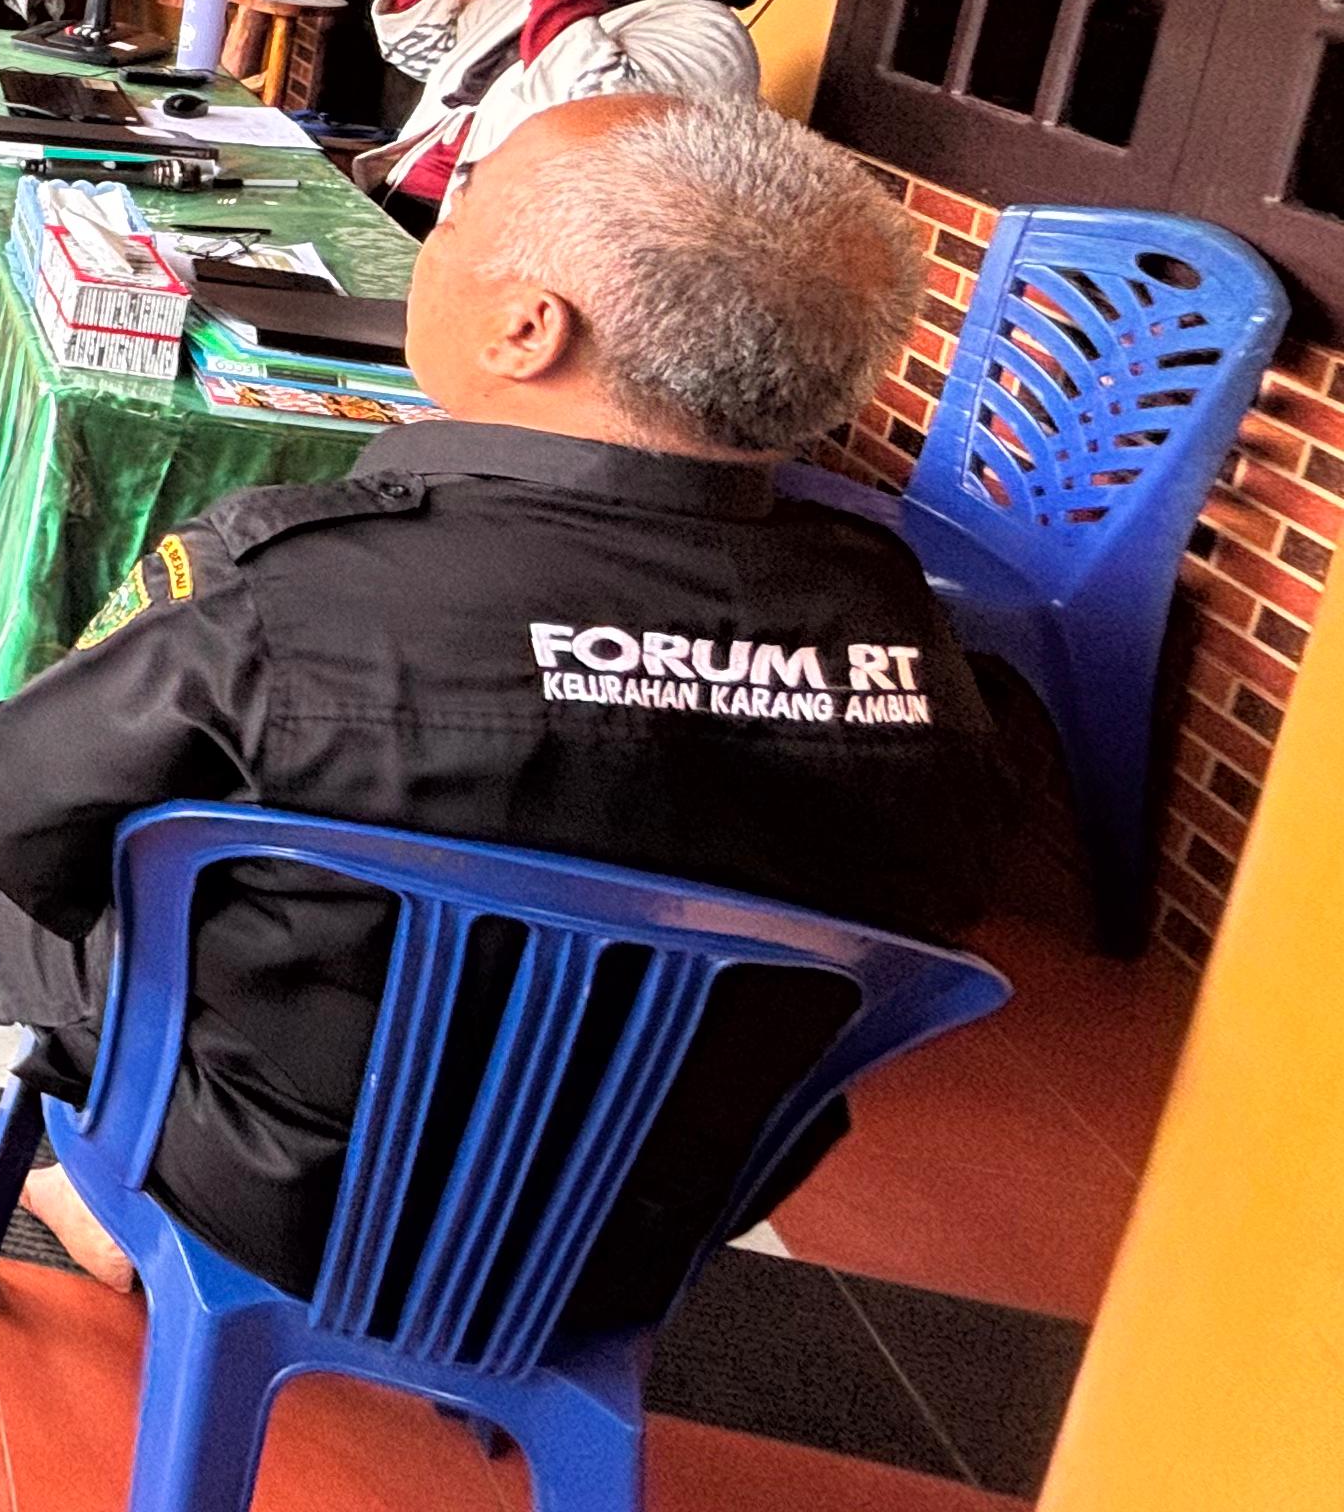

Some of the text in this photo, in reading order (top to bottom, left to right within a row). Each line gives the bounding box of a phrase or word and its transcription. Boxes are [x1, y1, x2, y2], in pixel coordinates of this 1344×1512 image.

[529, 623, 920, 691] FORUM RT
[542, 671, 933, 725] KELURAHAN KARANG AMBUN
